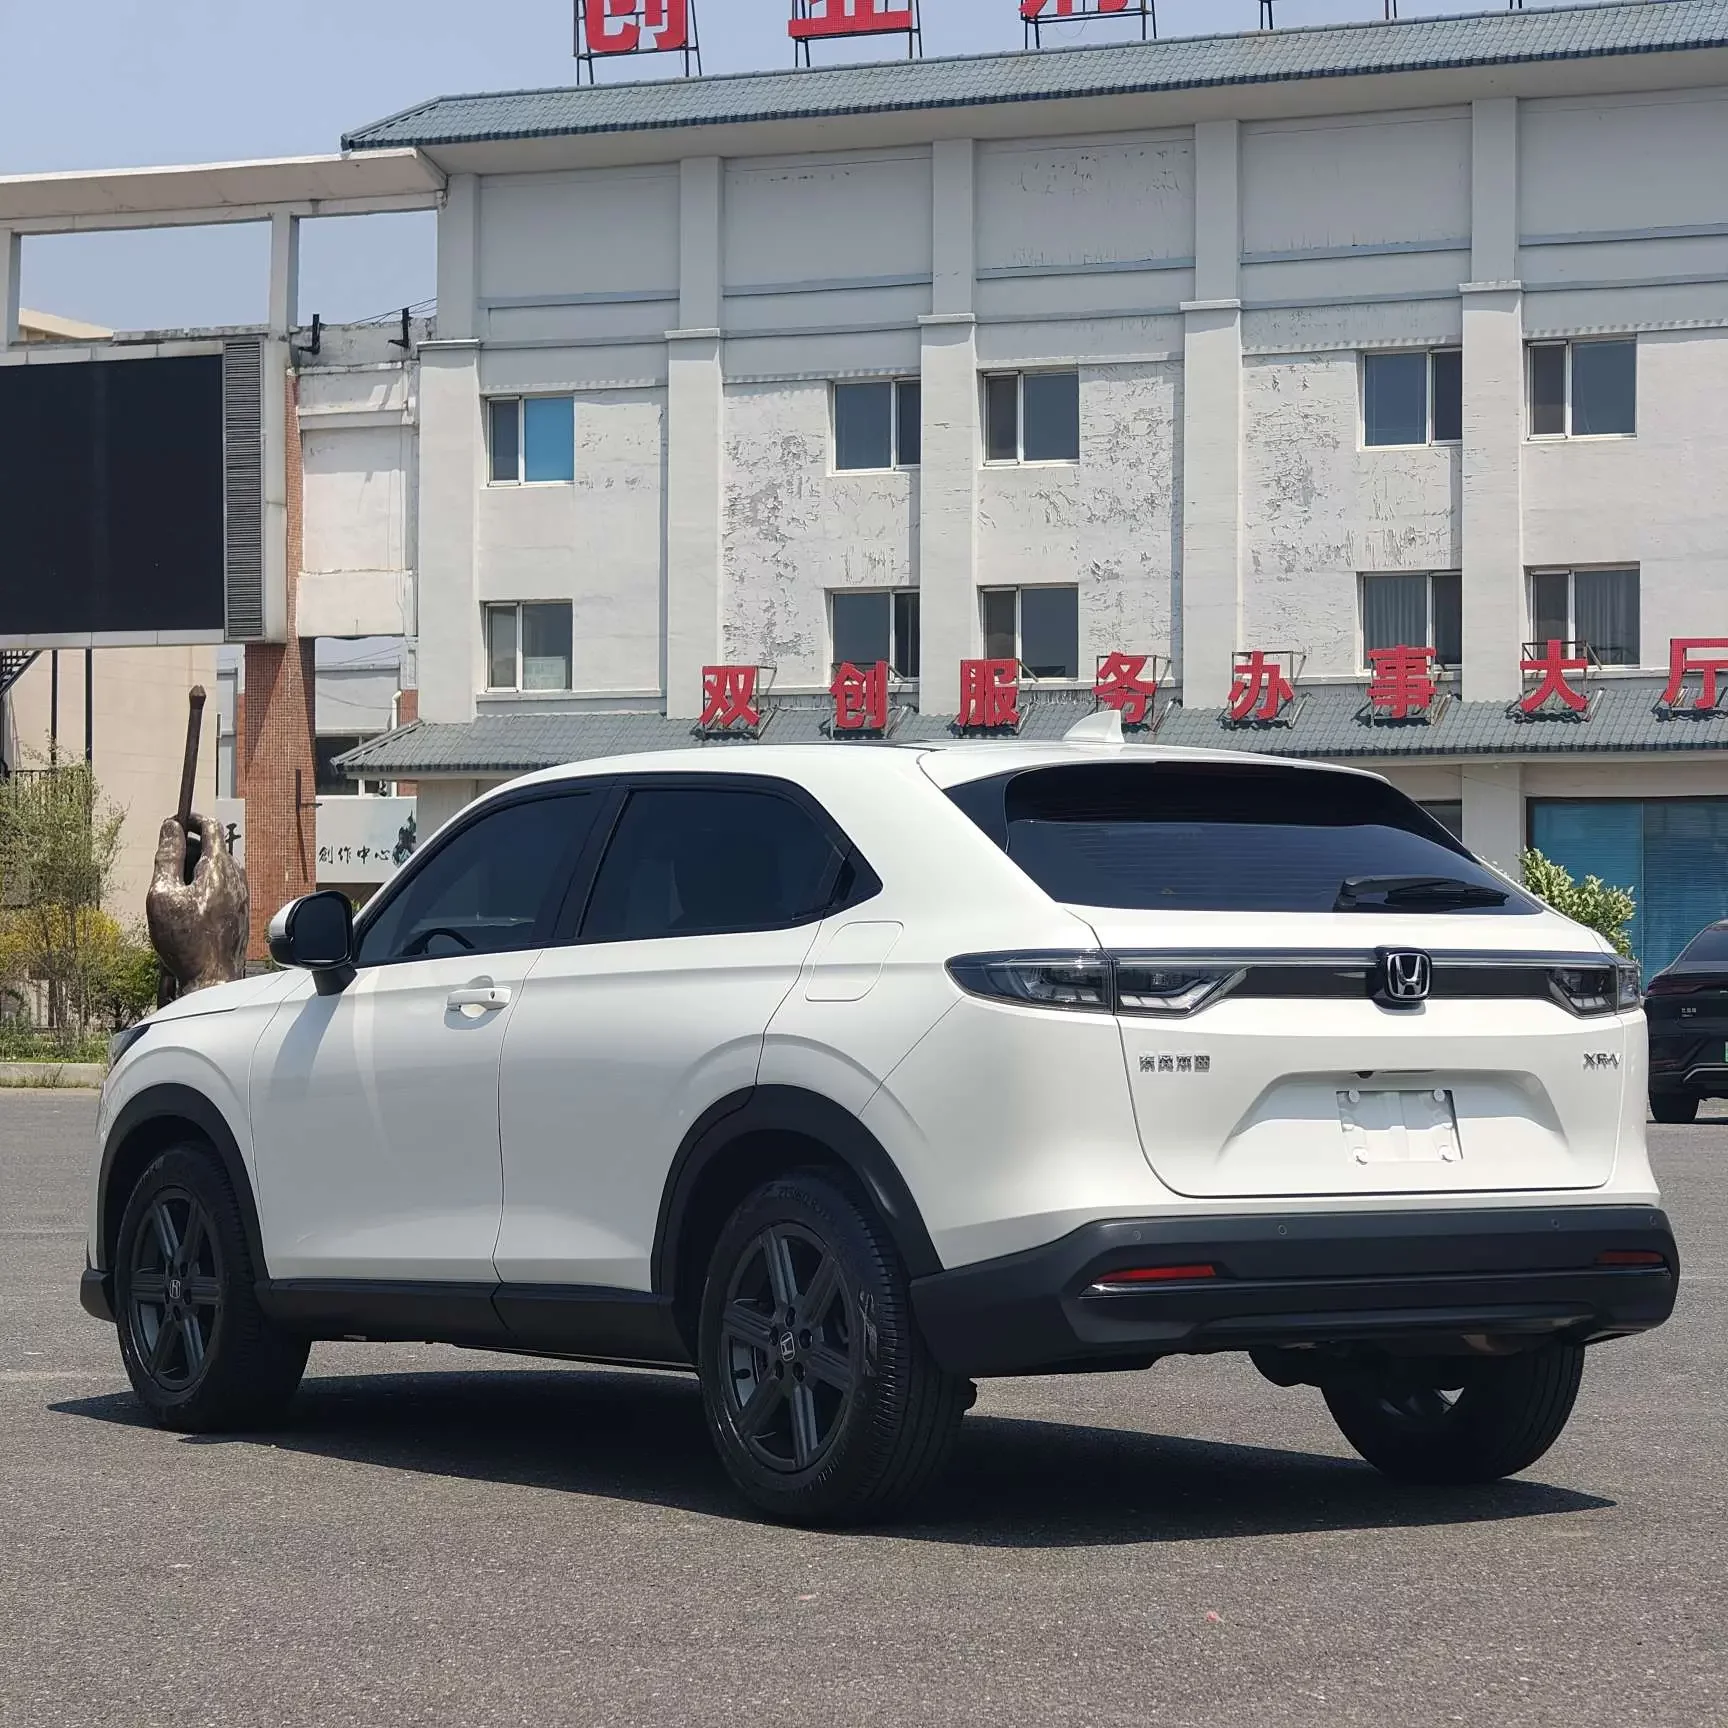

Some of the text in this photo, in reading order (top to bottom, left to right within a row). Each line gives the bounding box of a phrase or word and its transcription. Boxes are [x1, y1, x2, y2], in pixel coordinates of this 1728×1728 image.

[700, 638, 1728, 729] 双创服务办事大厅
